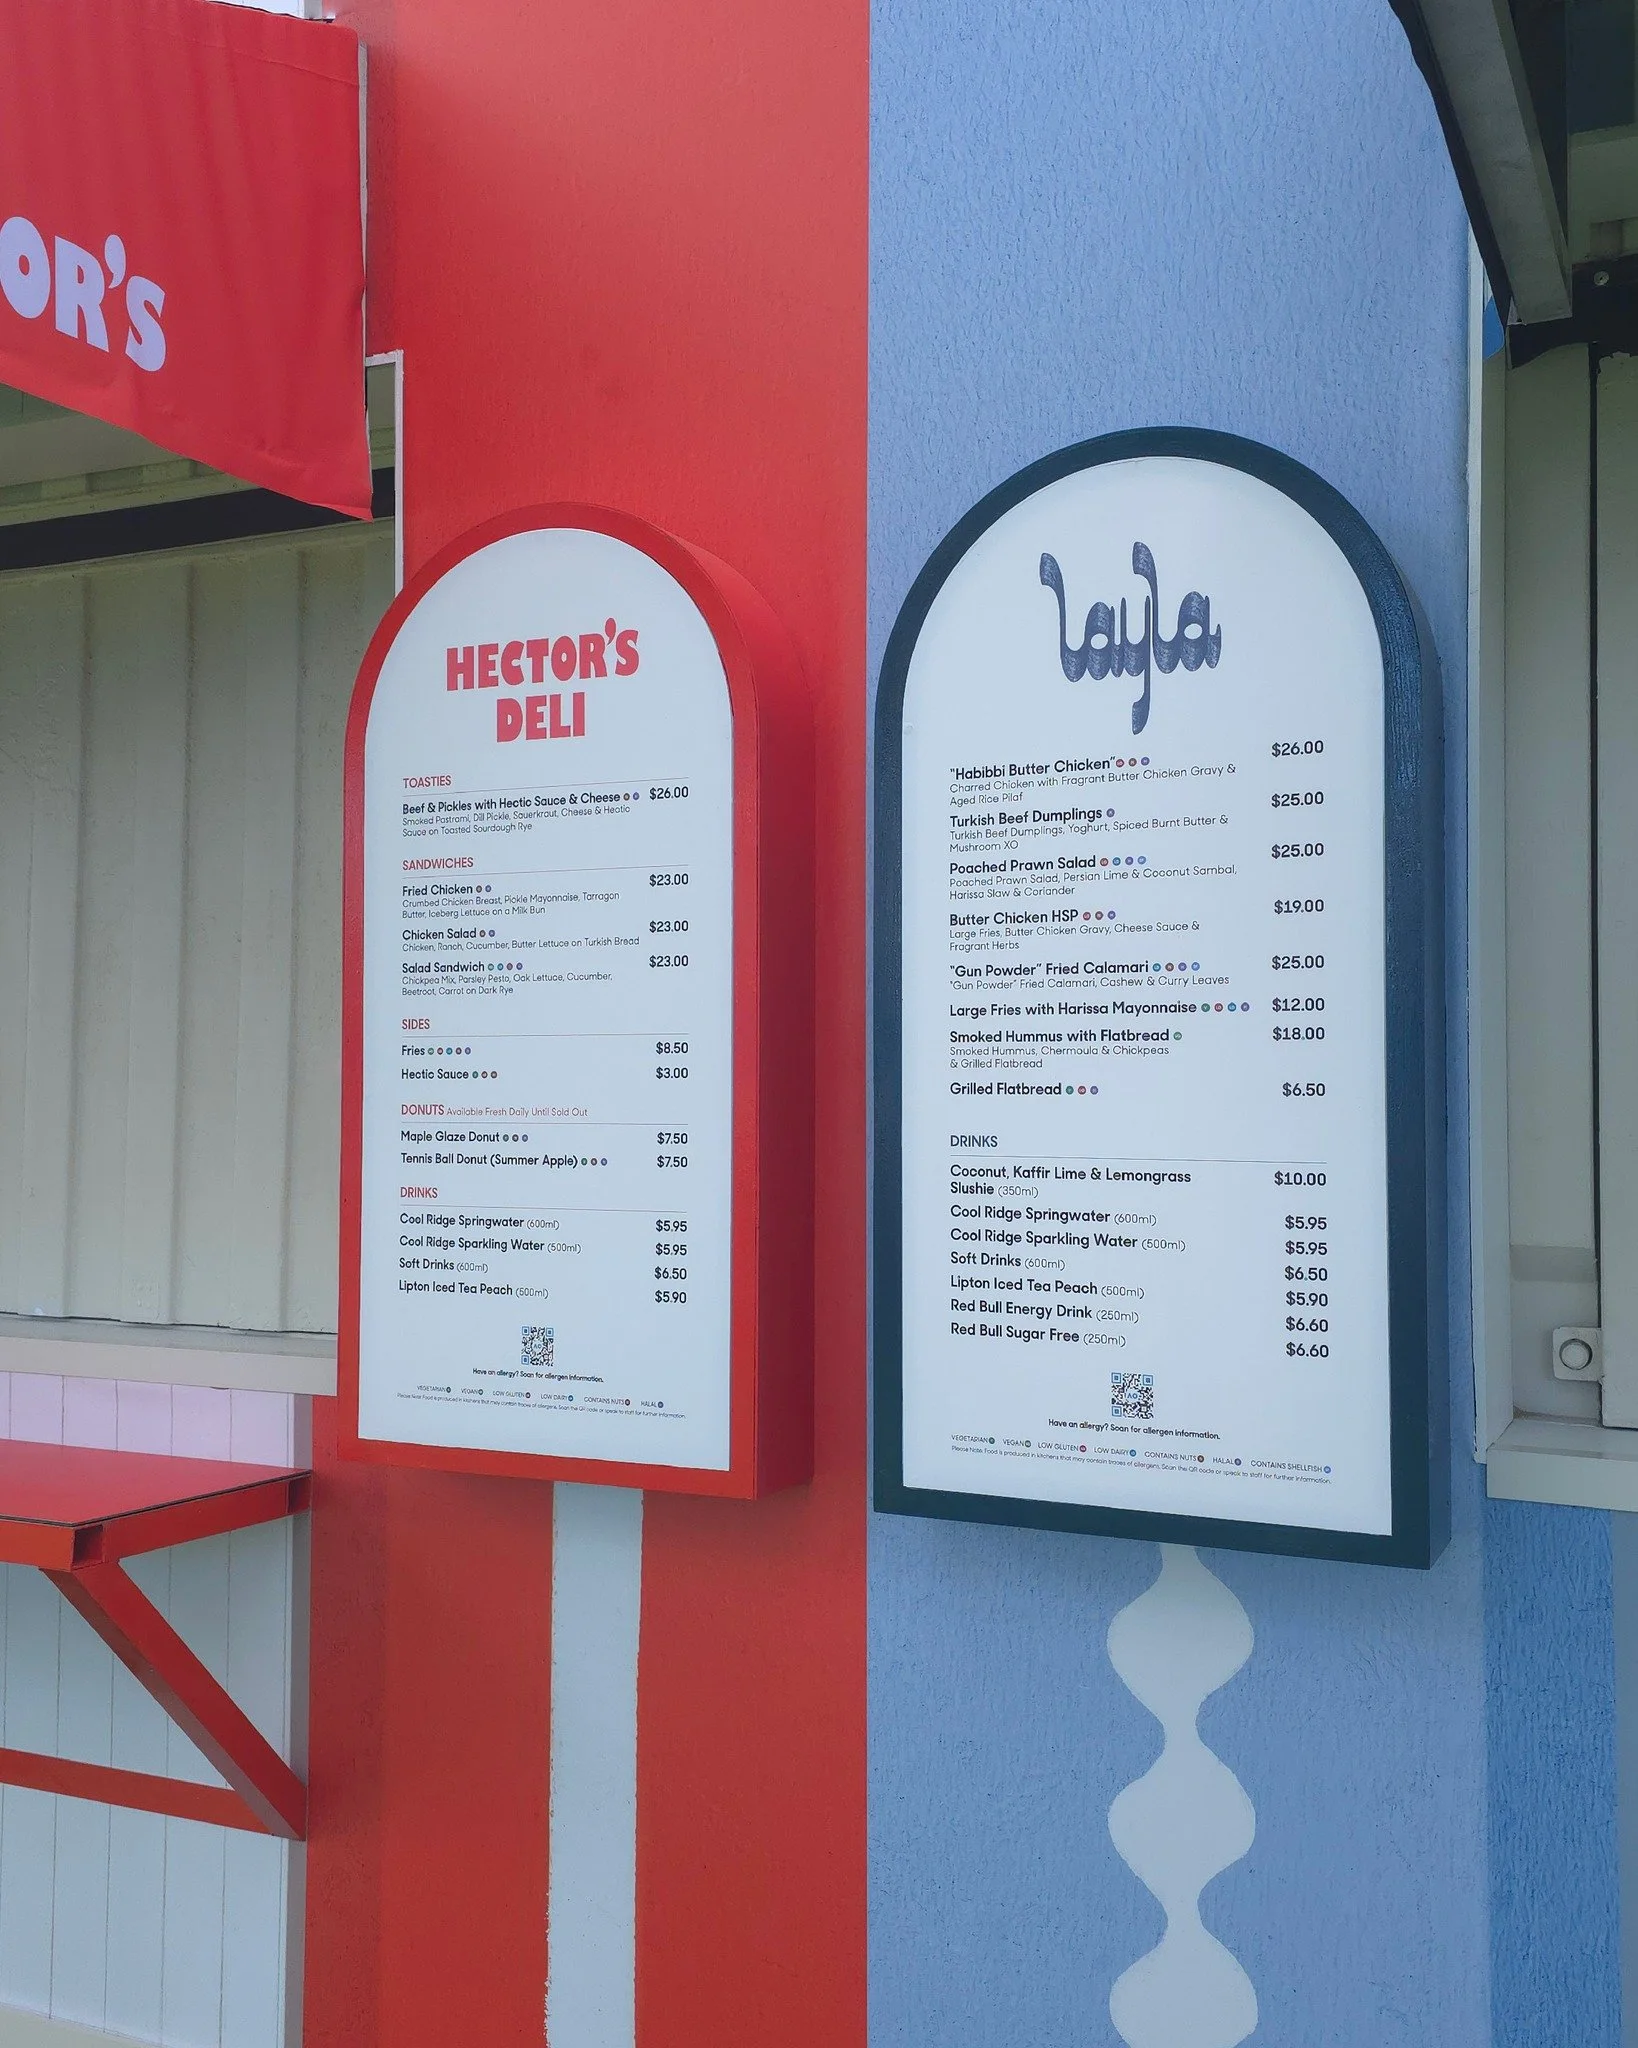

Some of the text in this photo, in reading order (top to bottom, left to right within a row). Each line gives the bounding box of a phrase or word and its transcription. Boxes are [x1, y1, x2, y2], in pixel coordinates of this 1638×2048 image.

[447, 617, 639, 691] HECTOR'S
[497, 692, 585, 742] DELI
[1271, 739, 1324, 758] $26.00
[1008, 762, 1050, 776] Butter
[402, 774, 451, 788] TOASTIES
[949, 763, 1236, 793] Charred Chicken with Fragrant Butter Chicken Gravy &
[649, 785, 688, 800] $26.00
[949, 791, 1023, 808] Aged Rice Pilaf
[1271, 790, 1324, 808] $25.00
[402, 791, 620, 815] Beef & Pickles with Hectic Sauce & Cheese
[949, 807, 1102, 827] Turkish Beef Dumplings
[949, 839, 1018, 852] Mushroom XO
[1271, 842, 1324, 859] $25.00
[402, 856, 473, 870] SANDWICHES
[949, 854, 1096, 874] Poached Prawn Salad
[649, 872, 688, 887] $23.00
[402, 883, 473, 896] Fried Chicken
[460, 908, 490, 916] Lettuce
[511, 905, 527, 914] Milk
[529, 905, 545, 914] Bun
[1273, 898, 1324, 915] $19.00
[949, 908, 1078, 926] Butter Chicken HSP
[402, 926, 476, 941] Chicken Salad
[648, 919, 688, 933] $23.00
[949, 939, 1019, 953] Fragrant Herbs
[402, 960, 484, 973] Salad Sandwich
[648, 954, 688, 968] $23.00
[1045, 961, 1079, 975] Fried
[1083, 959, 1148, 974] Calamari
[1271, 954, 1324, 971] $25.00
[949, 999, 1197, 1019] Large Fries with Harissa Mayonnaise
[1271, 996, 1324, 1012] $12.00
[401, 1018, 430, 1030] SIDES
[949, 1028, 1169, 1043] Smoked Hummus with Flatbread
[1272, 1025, 1325, 1041] $18.00
[401, 1044, 425, 1055] Fries
[655, 1040, 688, 1055] $8.50
[401, 1068, 469, 1079] Hectic Sauce
[655, 1065, 688, 1079] $3.00
[949, 1081, 1062, 1095] Grilled Flatbread
[1282, 1081, 1325, 1097] $6.50
[401, 1103, 587, 1118] DONUTS Available Fresh Daily Until Sold Out
[400, 1128, 499, 1144] Maple Glaze Donut
[656, 1131, 688, 1145] $7.50
[950, 1134, 998, 1147] DRINKS
[400, 1152, 578, 1169] Tennis Ball Donut (Summer Apple)
[656, 1154, 687, 1168] $7.50
[950, 1163, 1191, 1185] Coconut, Kaffir Lime & Lemongrass
[1273, 1170, 1326, 1186] $10.00
[400, 1186, 438, 1198] DRINKS
[950, 1181, 1038, 1199] Slushie (350ml)
[950, 1204, 1156, 1226] Cool Ridge Springwater (600ml)
[1284, 1214, 1327, 1230] $5.95
[399, 1234, 581, 1254] Cool Ridge Sparkling Water (500ml)
[655, 1242, 687, 1256] $5.95
[950, 1250, 1065, 1271] Soft Drinks (600ml)
[1284, 1264, 1327, 1281] $6.50
[398, 1279, 548, 1299] Lipton Iced Tea Peach (500ml)
[654, 1289, 686, 1303] $5.90
[950, 1298, 1139, 1324] Red Bull Energy Drink (250ml)
[1285, 1315, 1328, 1332] $6.60
